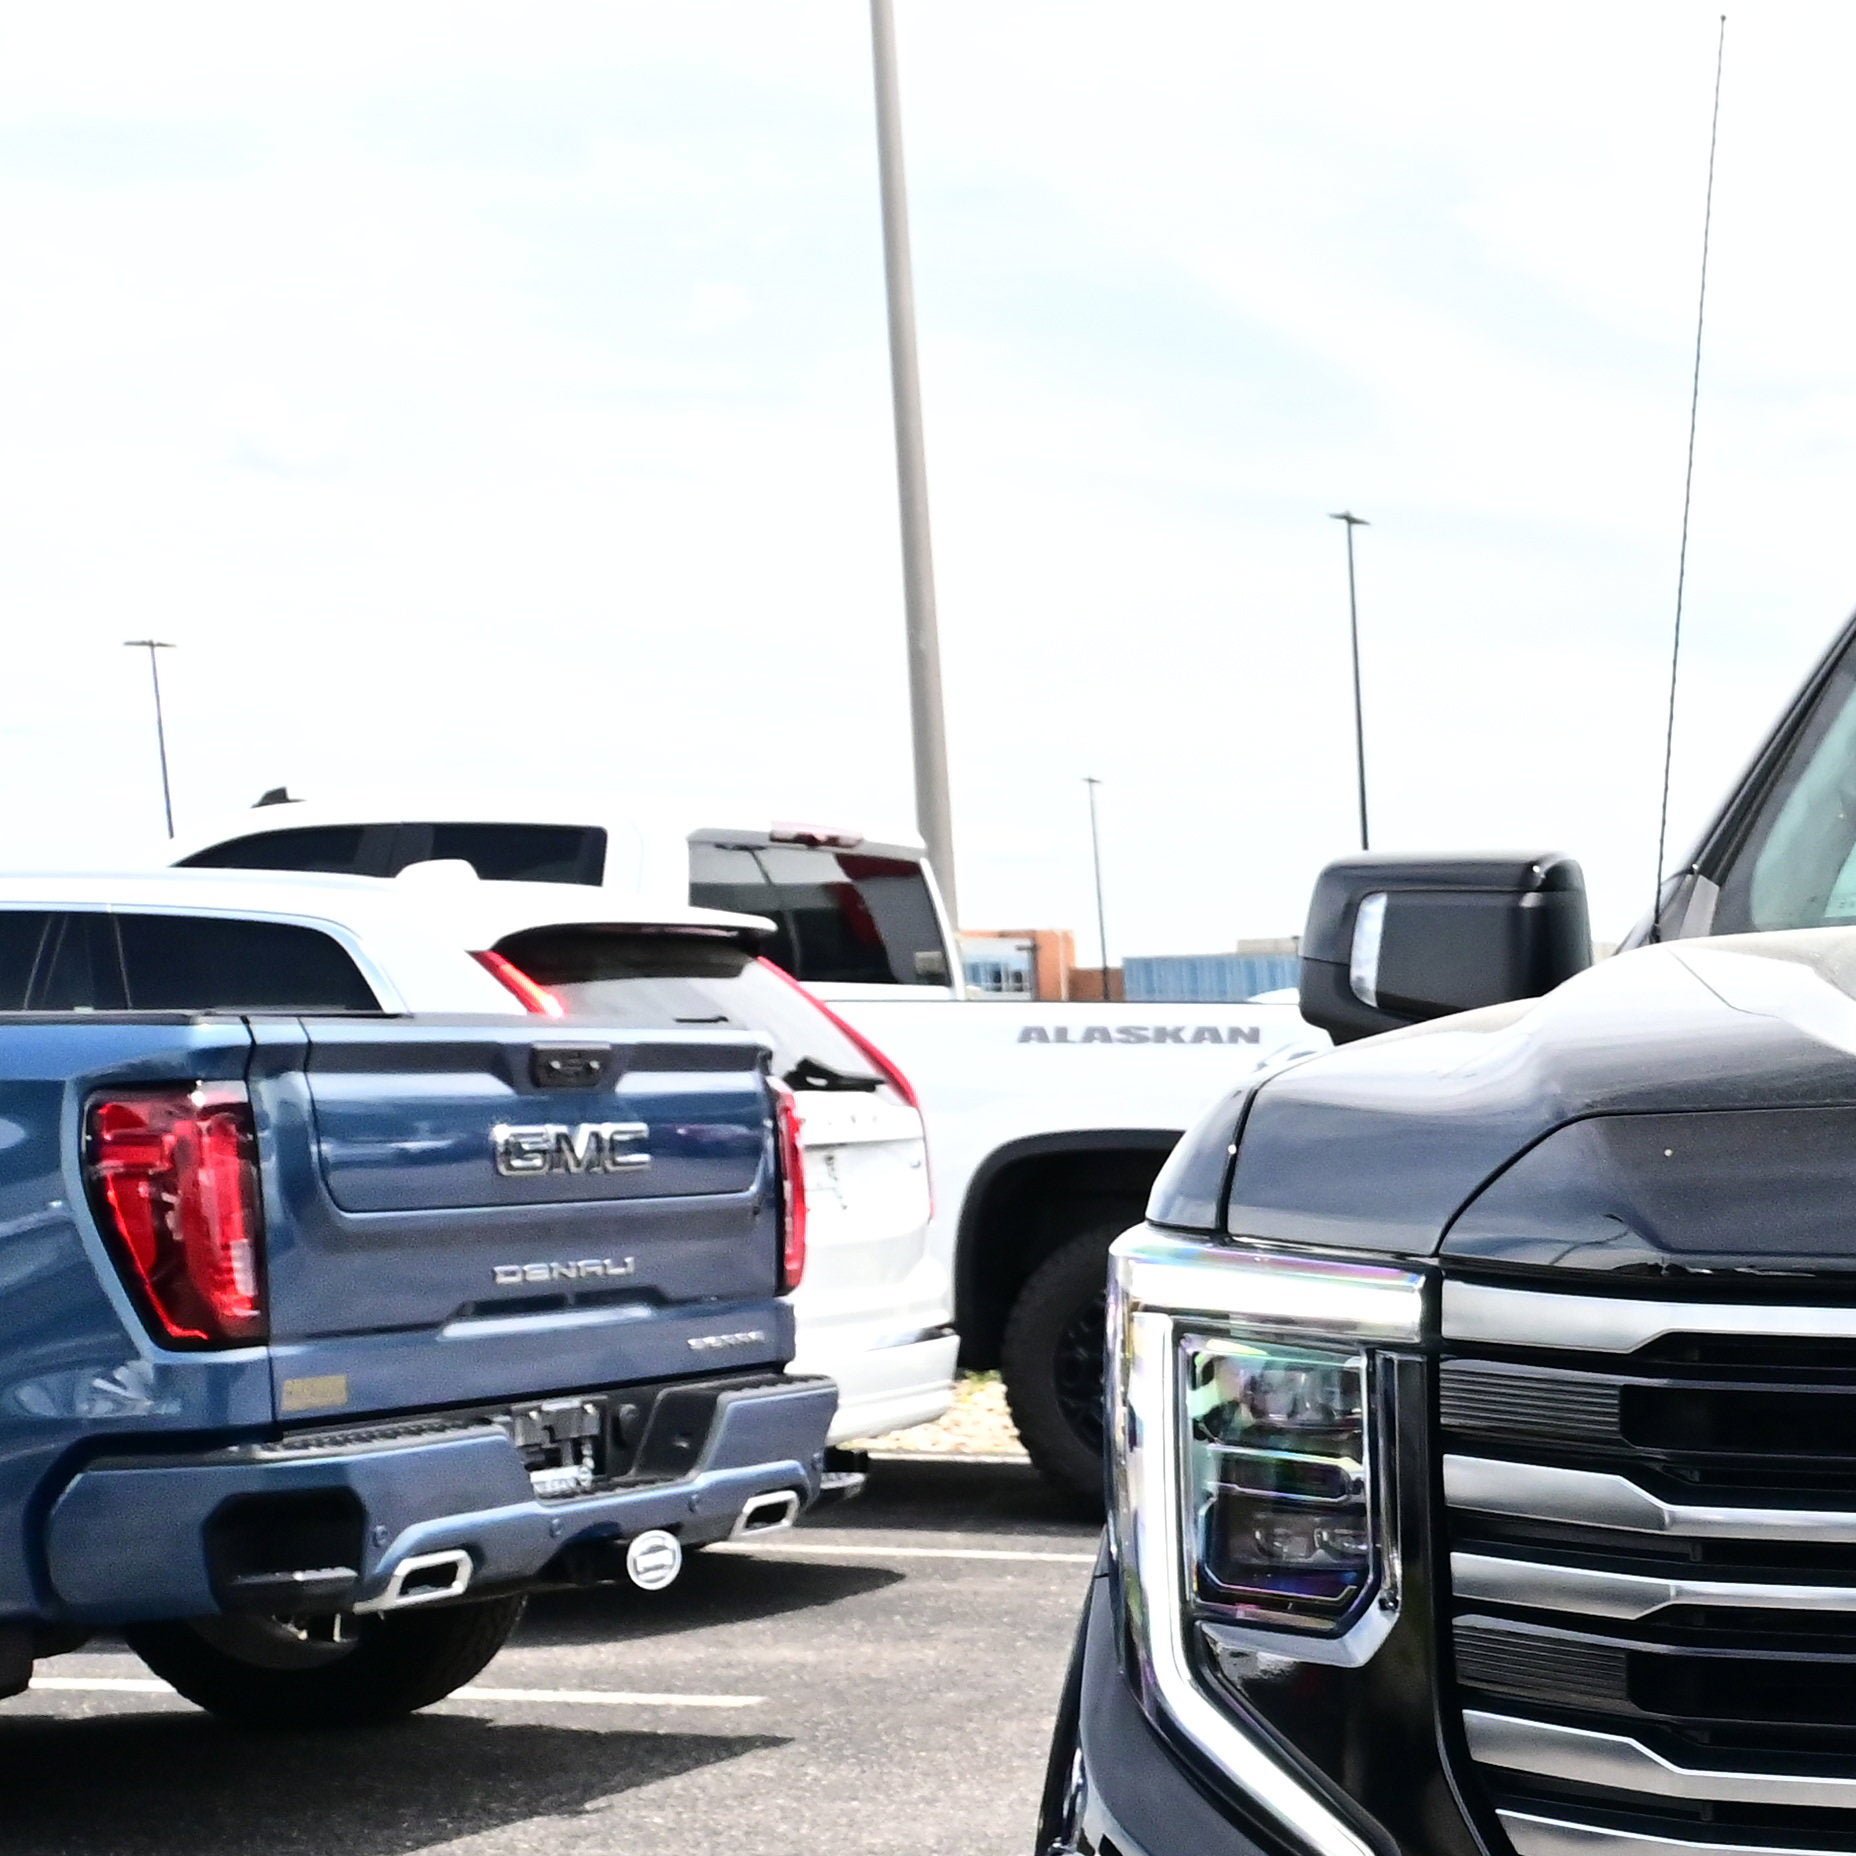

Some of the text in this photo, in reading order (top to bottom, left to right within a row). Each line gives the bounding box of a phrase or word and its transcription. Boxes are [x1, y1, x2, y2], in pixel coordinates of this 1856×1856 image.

[1017, 1025, 1261, 1045] ALASKAN
[490, 1122, 652, 1176] GMC
[492, 1256, 635, 1284] DENALI
